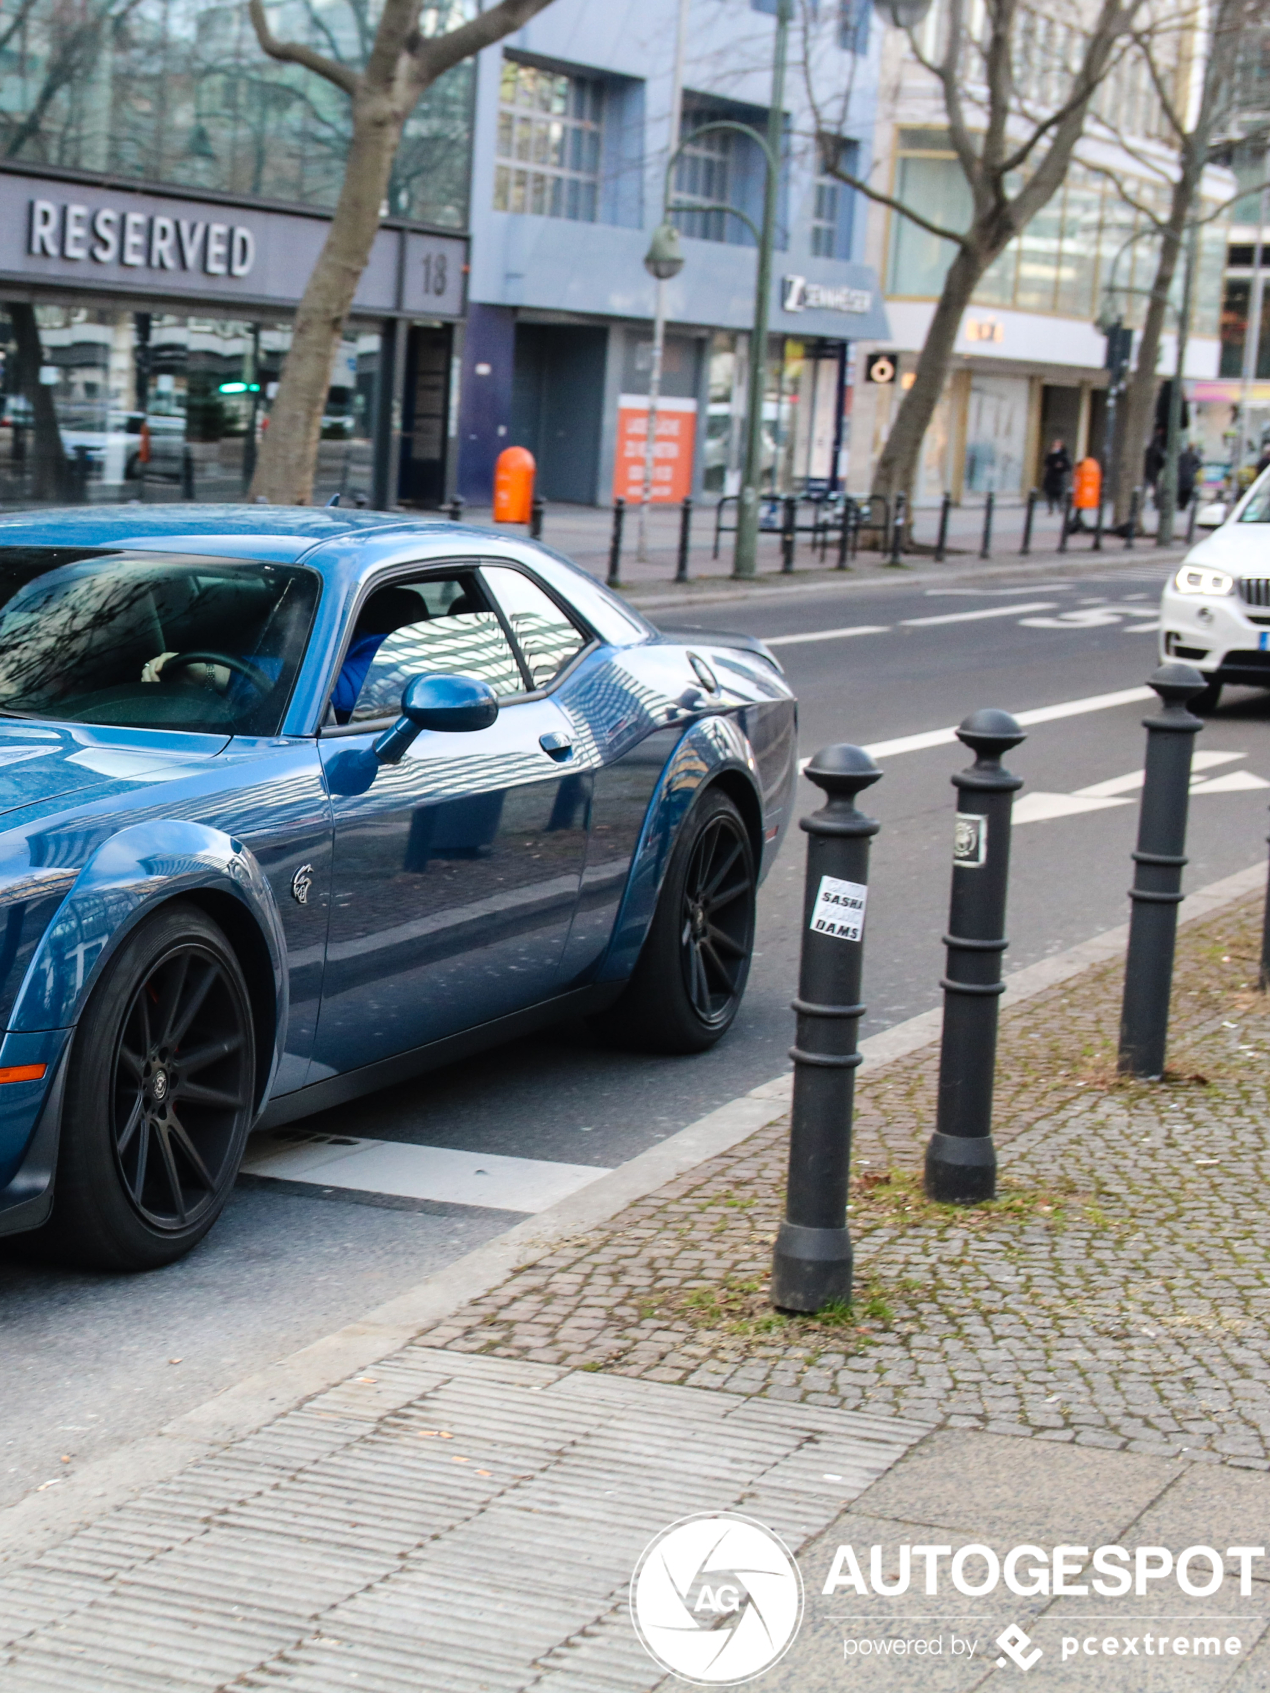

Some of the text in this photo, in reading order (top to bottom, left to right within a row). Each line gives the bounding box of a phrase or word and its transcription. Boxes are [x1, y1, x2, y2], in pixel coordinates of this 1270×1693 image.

[29, 199, 256, 277] RESERVED
[422, 253, 448, 297] 18
[815, 919, 859, 940] DAMS
